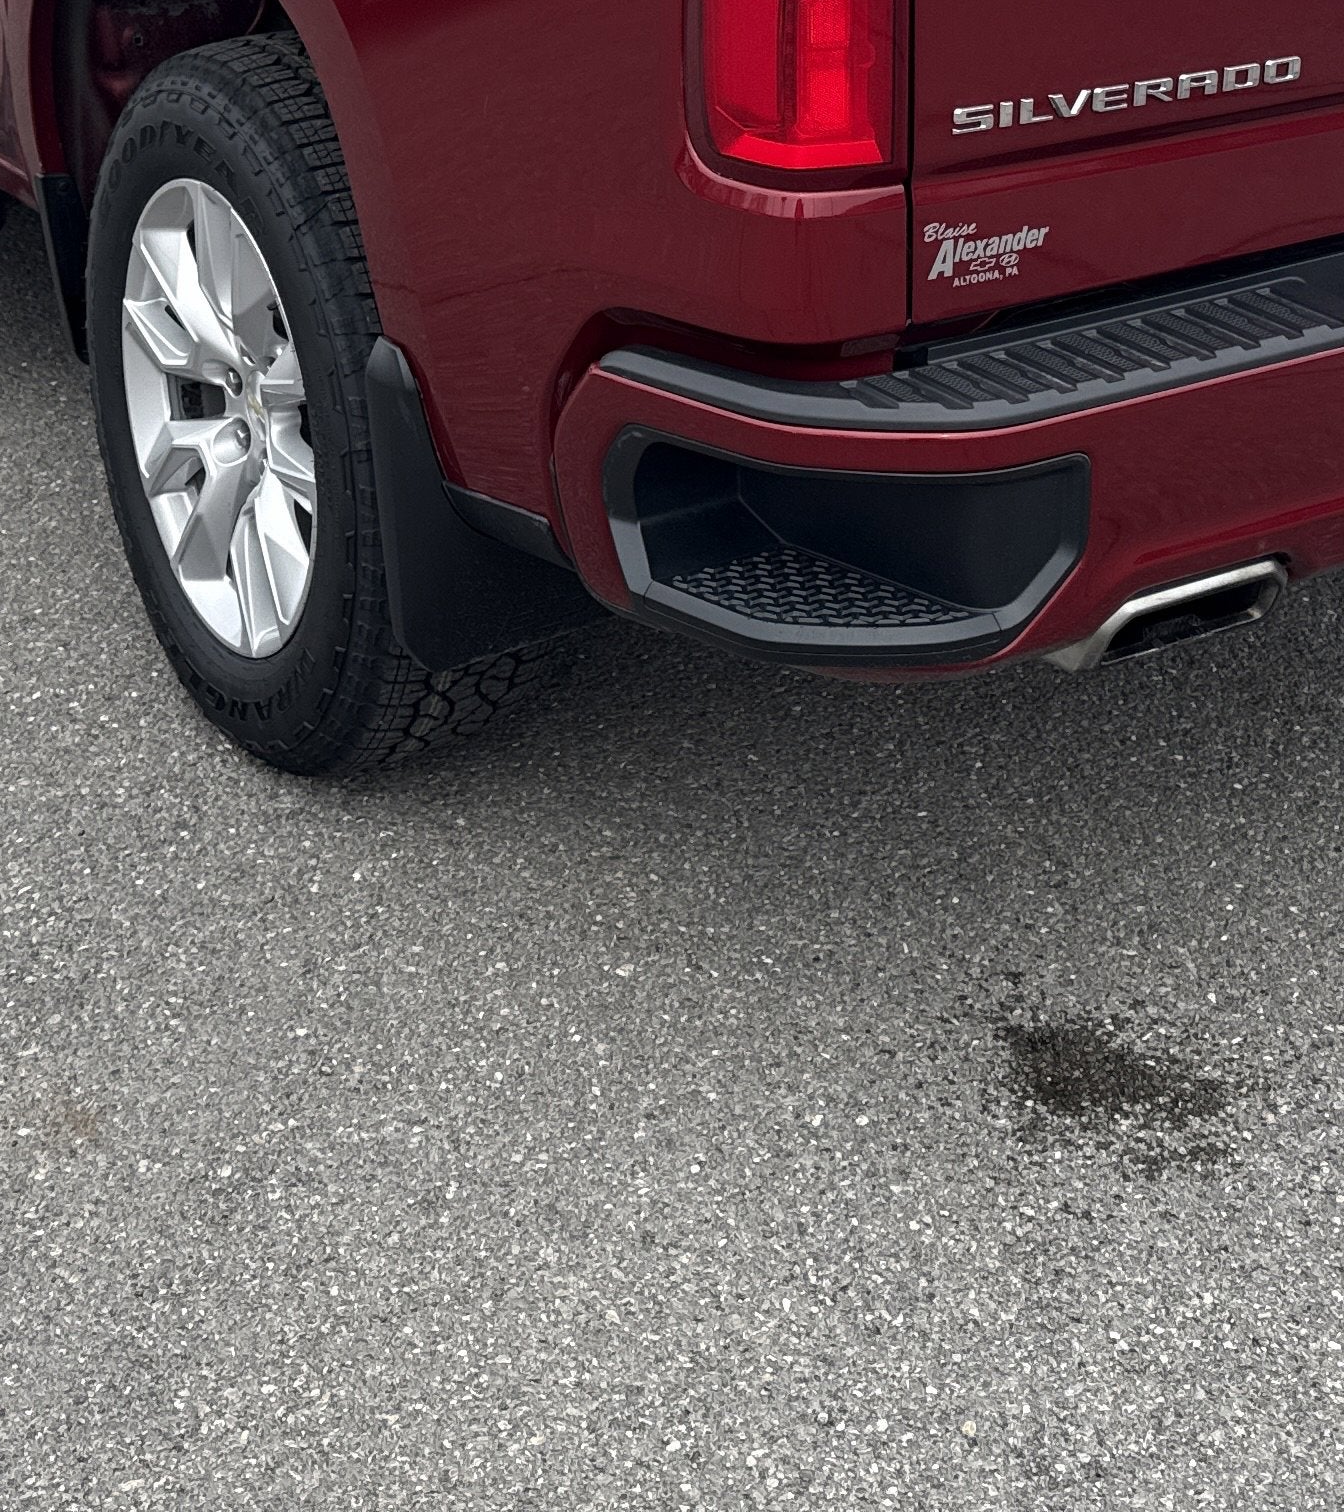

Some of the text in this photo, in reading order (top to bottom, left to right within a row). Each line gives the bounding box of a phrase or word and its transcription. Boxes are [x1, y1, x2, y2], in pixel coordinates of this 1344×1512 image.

[951, 55, 1302, 136] SILVERADO
[923, 222, 977, 243] Blaise
[927, 225, 1050, 280] Alexander
[952, 265, 1019, 288] ALTOONA, PA
